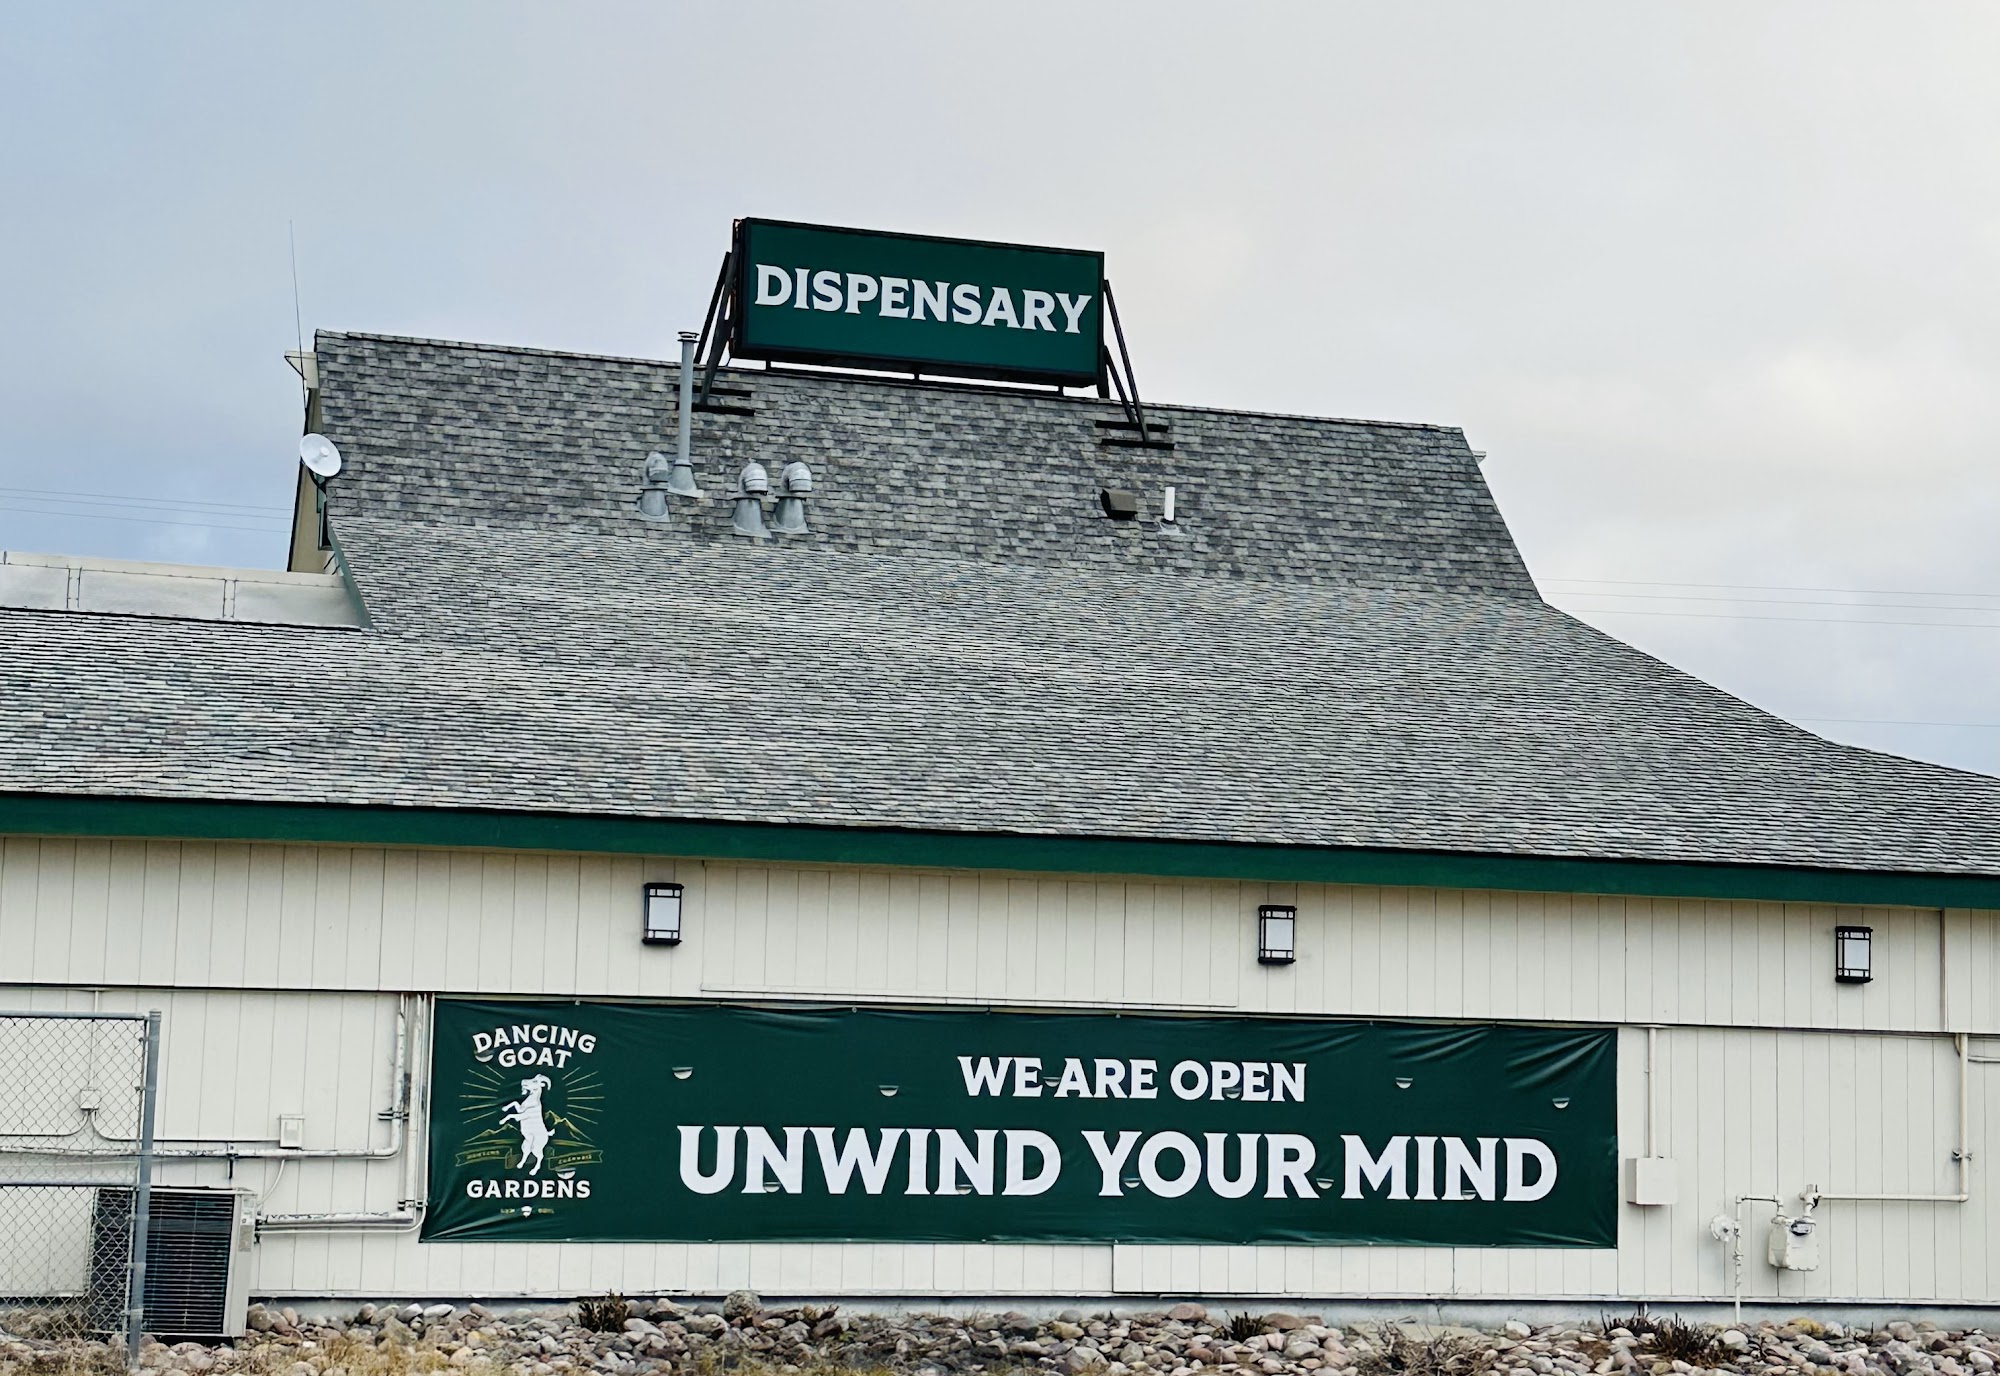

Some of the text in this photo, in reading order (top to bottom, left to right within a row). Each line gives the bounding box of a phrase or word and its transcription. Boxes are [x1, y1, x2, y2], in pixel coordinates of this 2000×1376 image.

[754, 264, 1092, 334] DISPENSARY
[472, 1024, 597, 1054] DANCING
[498, 1046, 572, 1069] GOAT
[957, 1056, 1307, 1102] WE ARE OPEN
[676, 1125, 1558, 1202] UNWIND YOUR MIND
[466, 1179, 591, 1199] GARDENS
